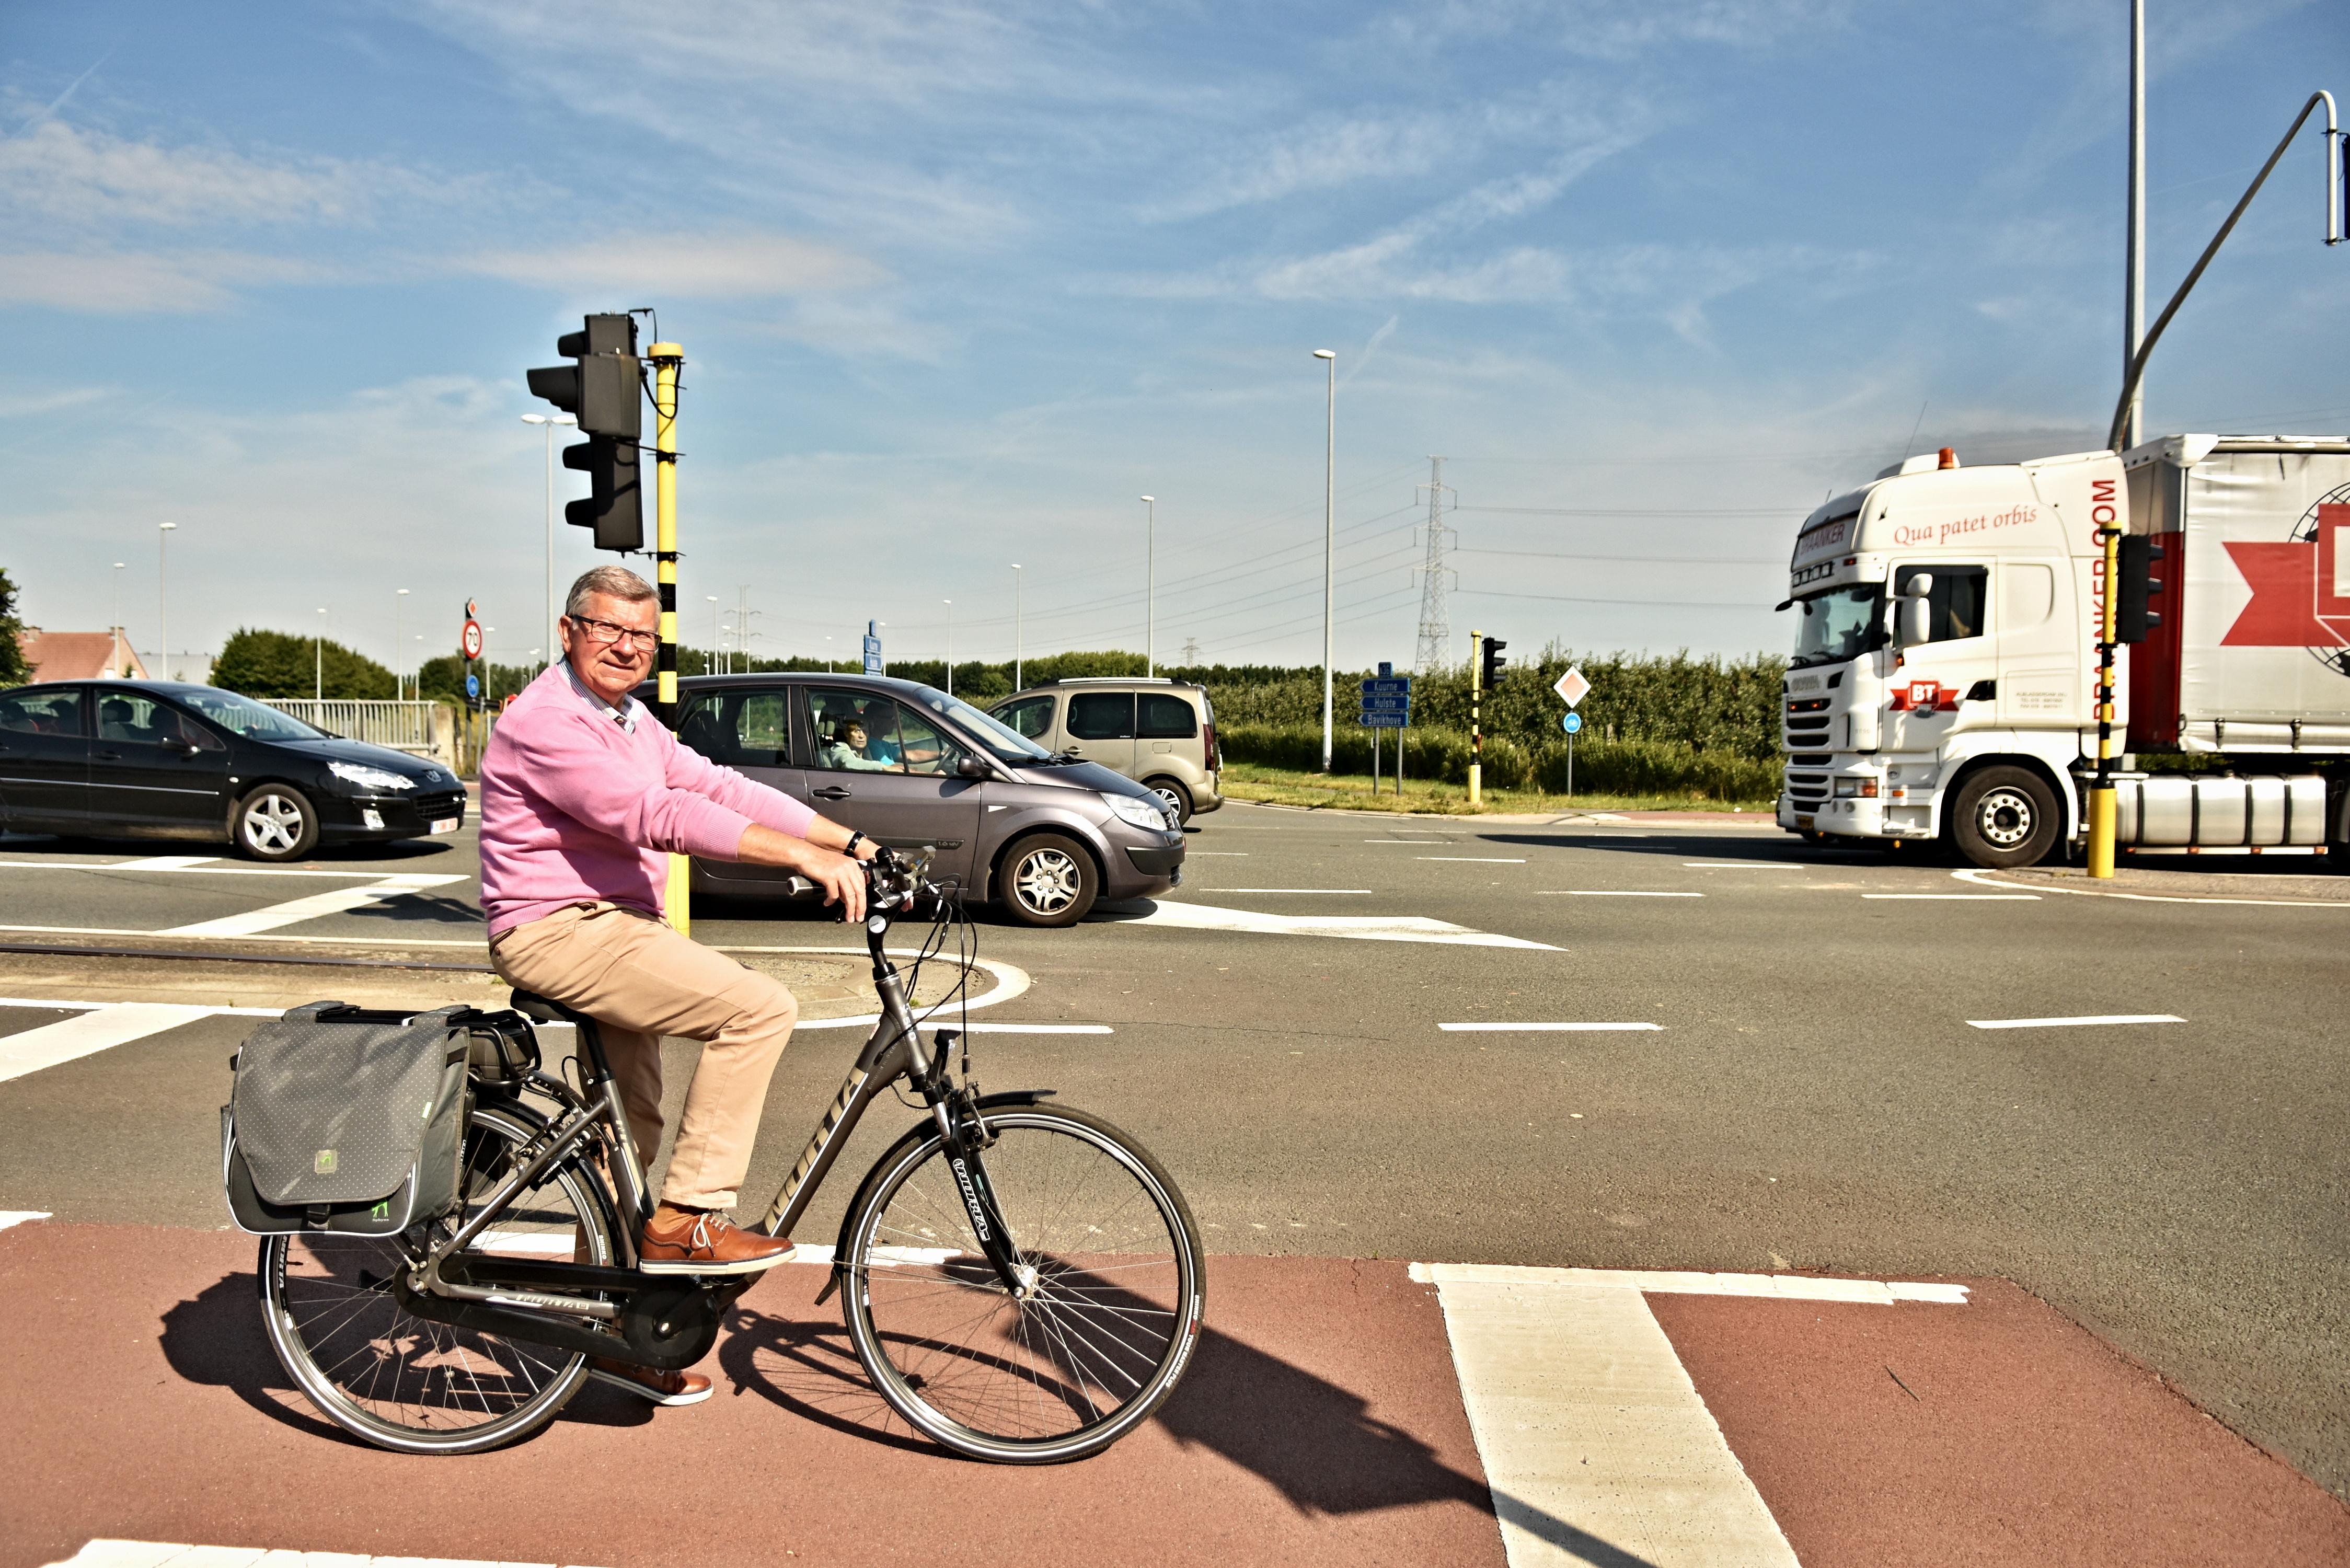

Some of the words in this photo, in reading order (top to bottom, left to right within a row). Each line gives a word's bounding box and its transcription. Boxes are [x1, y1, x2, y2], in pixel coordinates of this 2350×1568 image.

[1894, 525, 1933, 546] Qua
[1940, 515, 1987, 544] patet
[1993, 504, 2037, 528] orbis
[467, 631, 478, 647] 70
[1380, 664, 1390, 675] N36
[1374, 681, 1398, 691] Kuurne
[1912, 684, 1936, 702] BT
[1374, 697, 1396, 708] Hulste
[1367, 714, 1402, 724] Bavikhove
[764, 1067, 867, 1235] NORTA
[538, 1160, 561, 1183] TRELOCK
[956, 1167, 988, 1233] NORTA
[598, 1235, 607, 1260] SHINKO
[1184, 1334, 1194, 1352] TOUR
[1174, 1351, 1188, 1374] MASTER
[1166, 1373, 1177, 1388] PLUS
